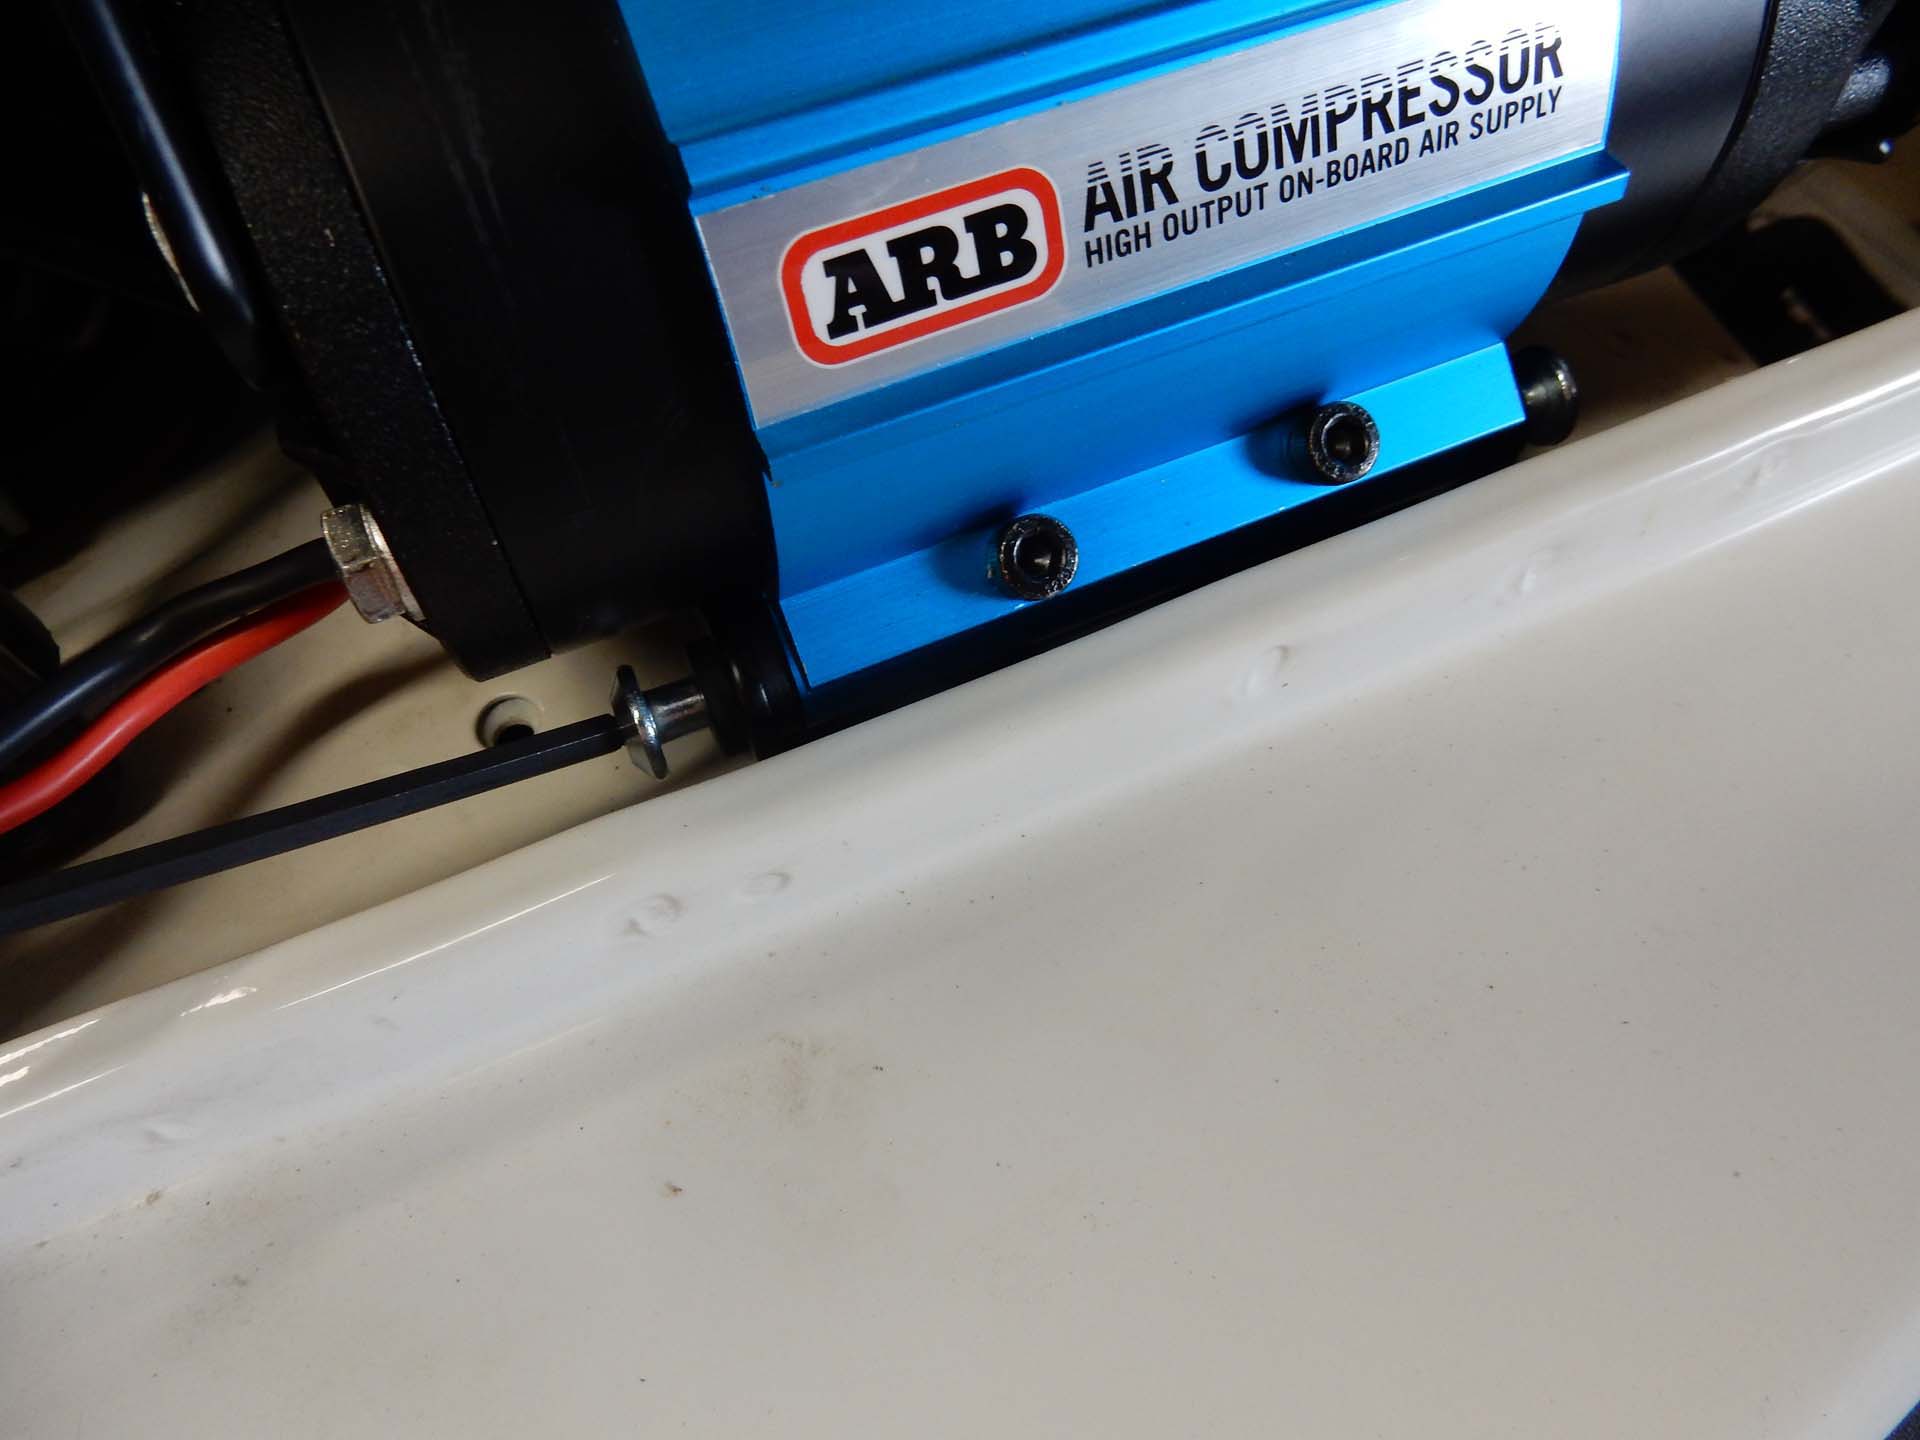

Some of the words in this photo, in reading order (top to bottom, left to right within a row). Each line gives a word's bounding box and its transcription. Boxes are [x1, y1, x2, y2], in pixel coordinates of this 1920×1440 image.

[1083, 143, 1175, 233] AIR
[1195, 23, 1564, 192] COMPRESSOR
[1085, 221, 1152, 267] HIGH
[1163, 185, 1266, 243] OUTPUT
[1279, 138, 1410, 203] ON-BOARD
[1418, 121, 1461, 158] AIR
[1470, 86, 1562, 141] SUPPLY
[822, 203, 1038, 339] ARB
